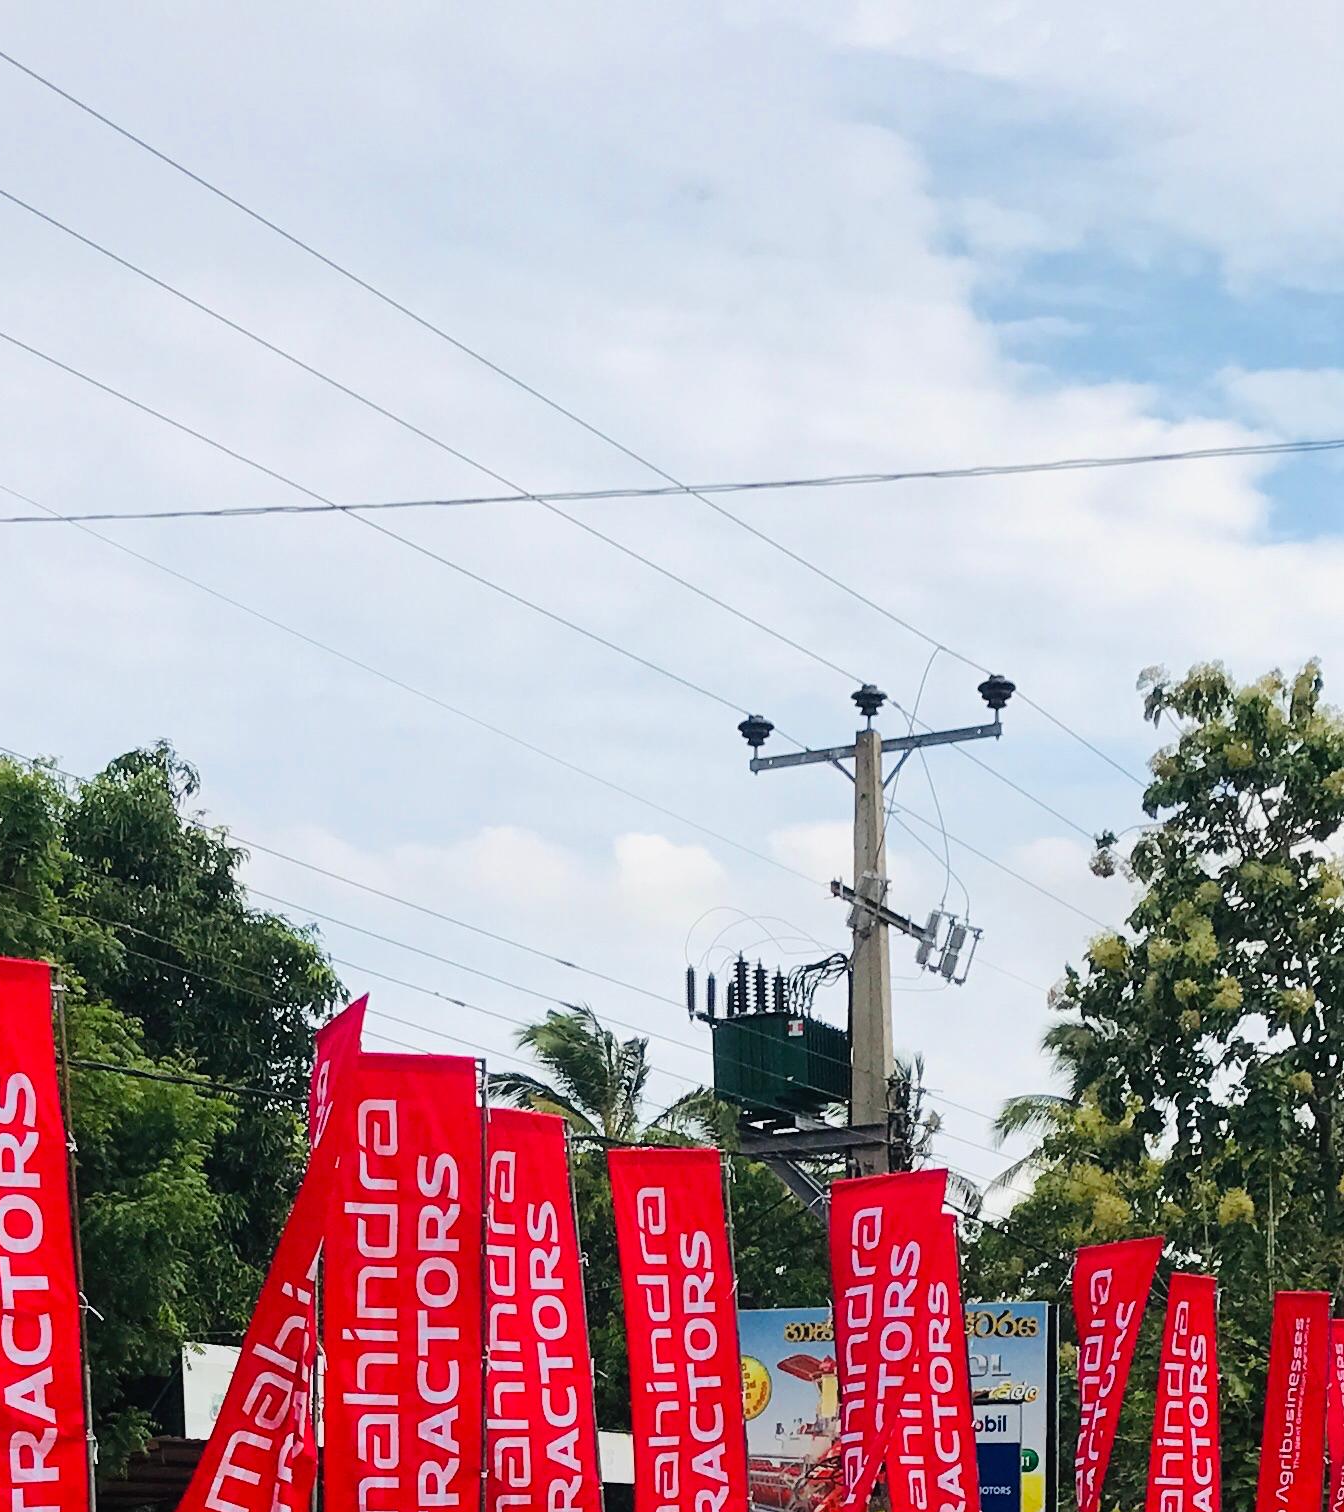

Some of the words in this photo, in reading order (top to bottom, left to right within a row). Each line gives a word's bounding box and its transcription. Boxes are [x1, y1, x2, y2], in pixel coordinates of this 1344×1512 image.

[839, 1205, 884, 1504] ahindra
[875, 1239, 922, 1433] CTORS
[974, 1415, 1007, 1433] obil
[1275, 1317, 1305, 1503] Agribusinesses
